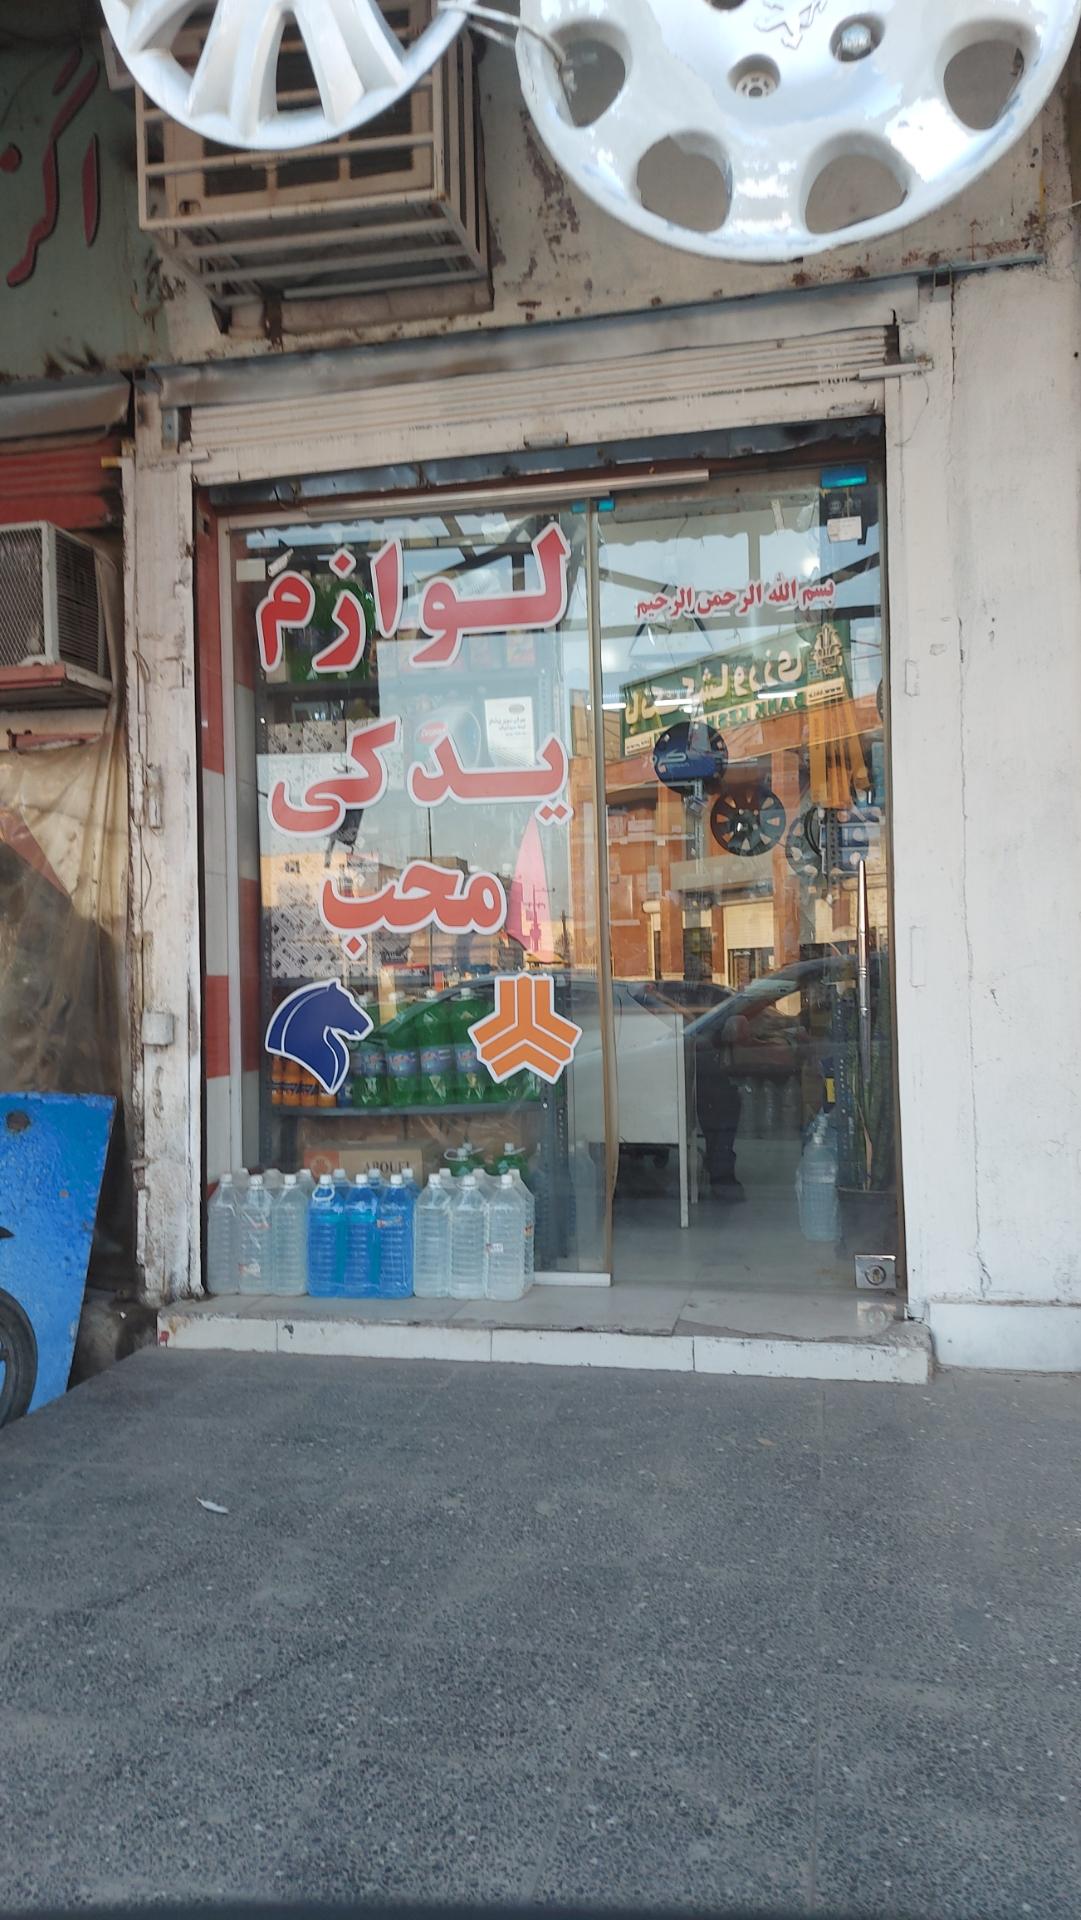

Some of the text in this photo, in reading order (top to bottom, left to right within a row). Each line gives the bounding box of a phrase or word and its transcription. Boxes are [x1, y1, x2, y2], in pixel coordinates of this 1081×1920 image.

[257, 522, 571, 671] لوازم
[637, 573, 835, 620] بسم الله الرحمن الرحیم
[268, 716, 573, 836] یدکی
[319, 860, 507, 960] محب
